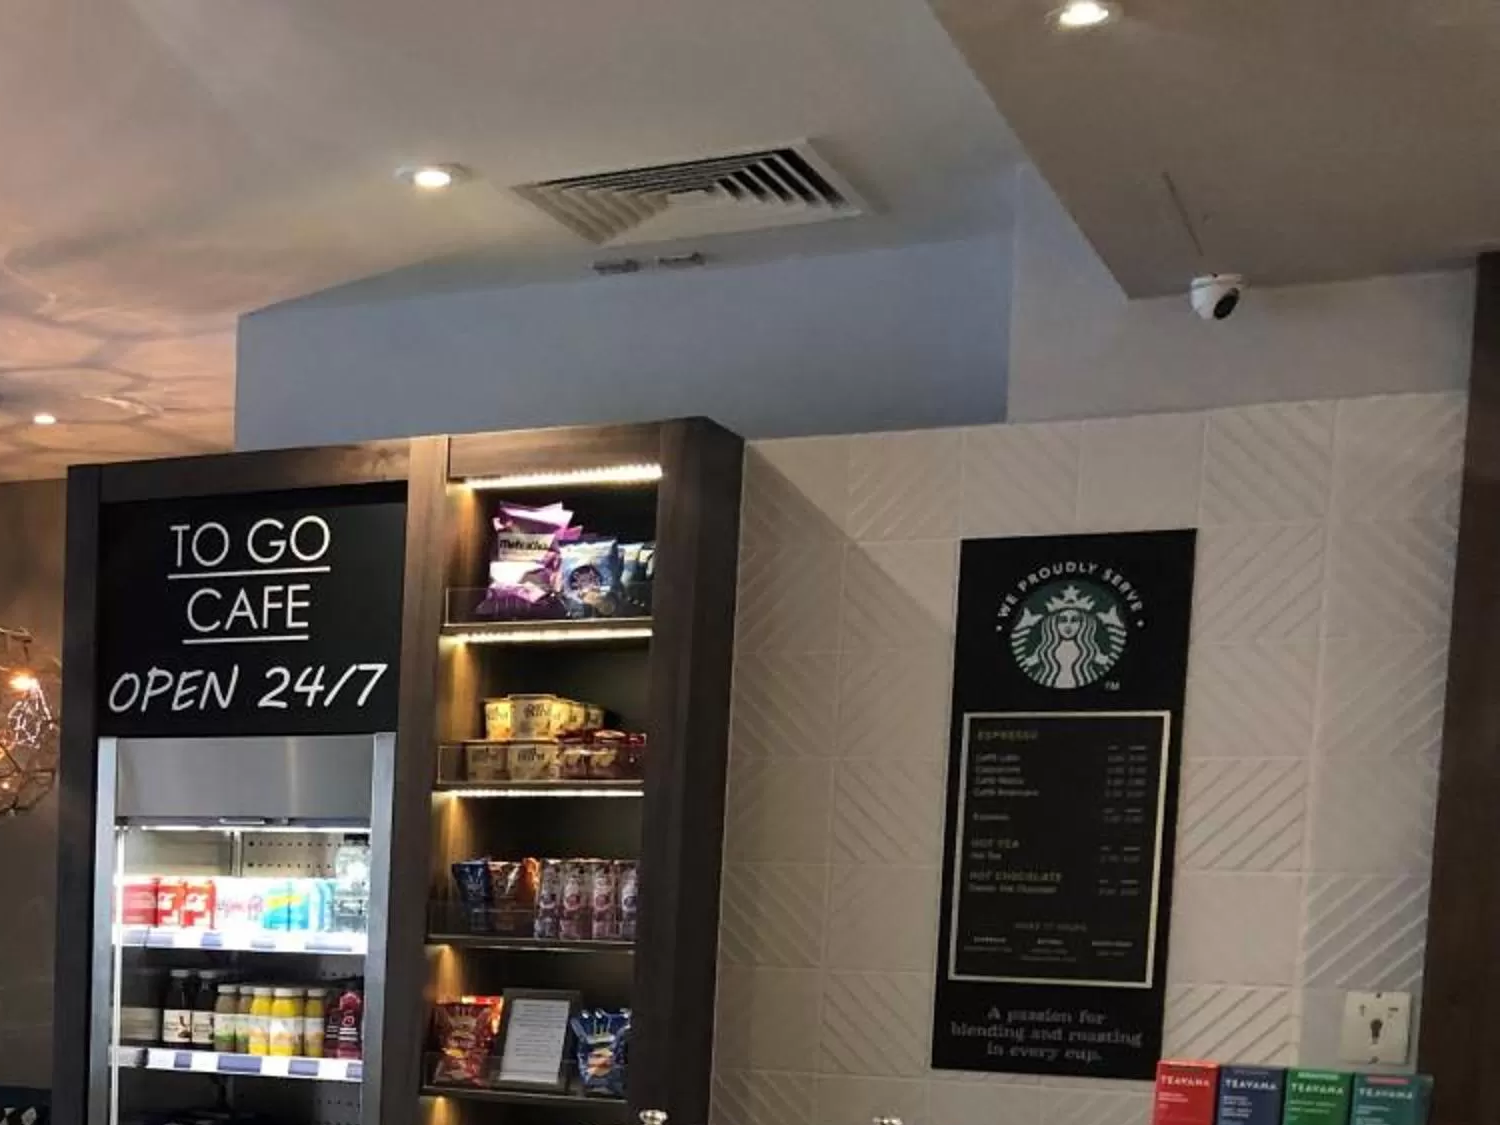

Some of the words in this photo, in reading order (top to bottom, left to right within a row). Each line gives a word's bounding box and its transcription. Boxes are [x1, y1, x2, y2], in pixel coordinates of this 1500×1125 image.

[169, 521, 230, 569] TO
[247, 515, 331, 564] GO
[997, 593, 1019, 617] WE
[1017, 561, 1098, 592] PROUDLY
[1102, 567, 1143, 612] SERVE
[187, 583, 311, 632] CAFE
[108, 663, 239, 713] OPEN
[257, 663, 388, 708] 24/7
[987, 1005, 1001, 1020] A
[1006, 1008, 1073, 1024] passion
[1078, 1009, 1106, 1024] for
[950, 1021, 1025, 1042] blending
[1030, 1027, 1063, 1041] and
[1068, 1030, 1144, 1047] roasting
[986, 1041, 1004, 1056] in
[1009, 1046, 1060, 1061] every
[1161, 1075, 1211, 1088] TEAVANA
[1225, 1078, 1278, 1090] TEAVANA
[1290, 1083, 1344, 1096] TEAVANA
